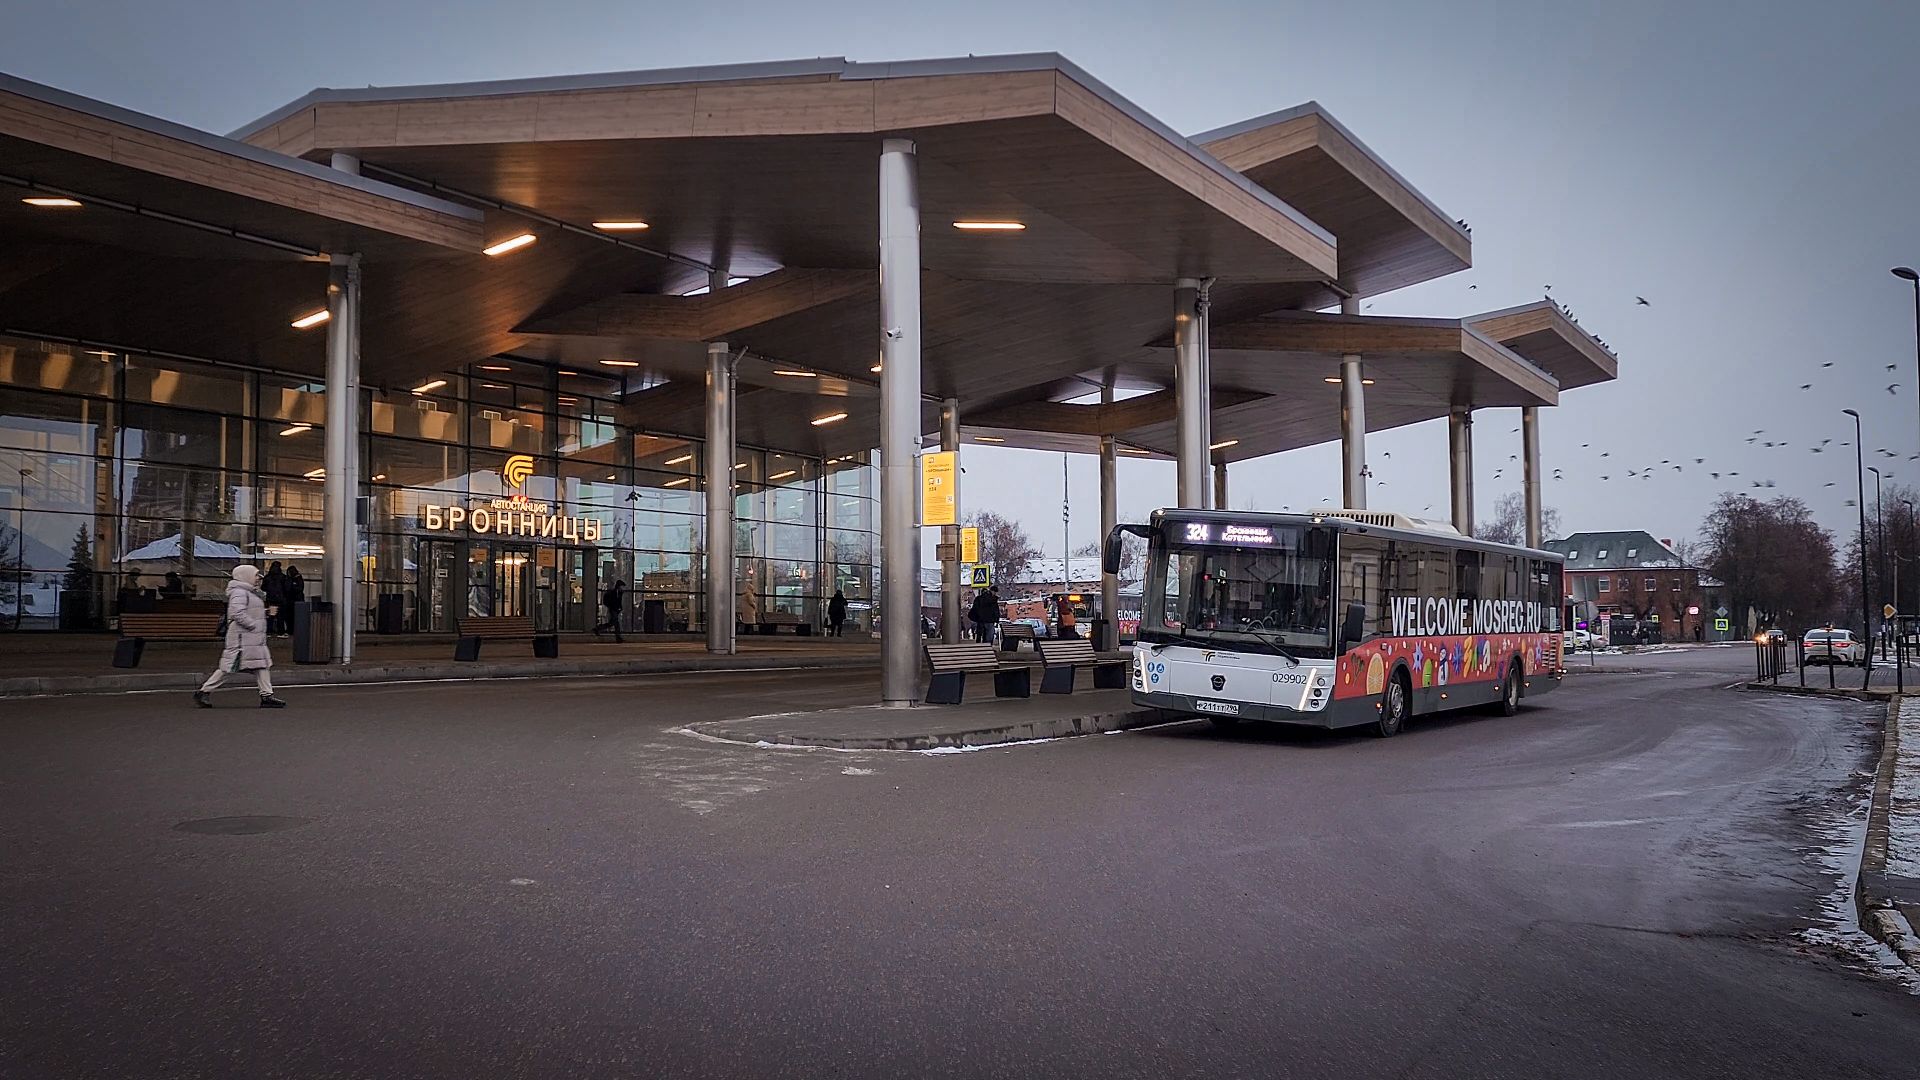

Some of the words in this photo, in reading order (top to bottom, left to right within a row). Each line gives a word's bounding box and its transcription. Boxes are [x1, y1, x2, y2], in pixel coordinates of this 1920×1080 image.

[490, 499, 548, 514] АВТОСТАНЦИЯ
[425, 504, 601, 545] БРОННИЦЫ
[1186, 523, 1209, 541] 324
[1117, 609, 1141, 621] ELCOME
[1390, 596, 1542, 637] WELCOME.MOSREG.RU
[1272, 673, 1307, 685] 029902
